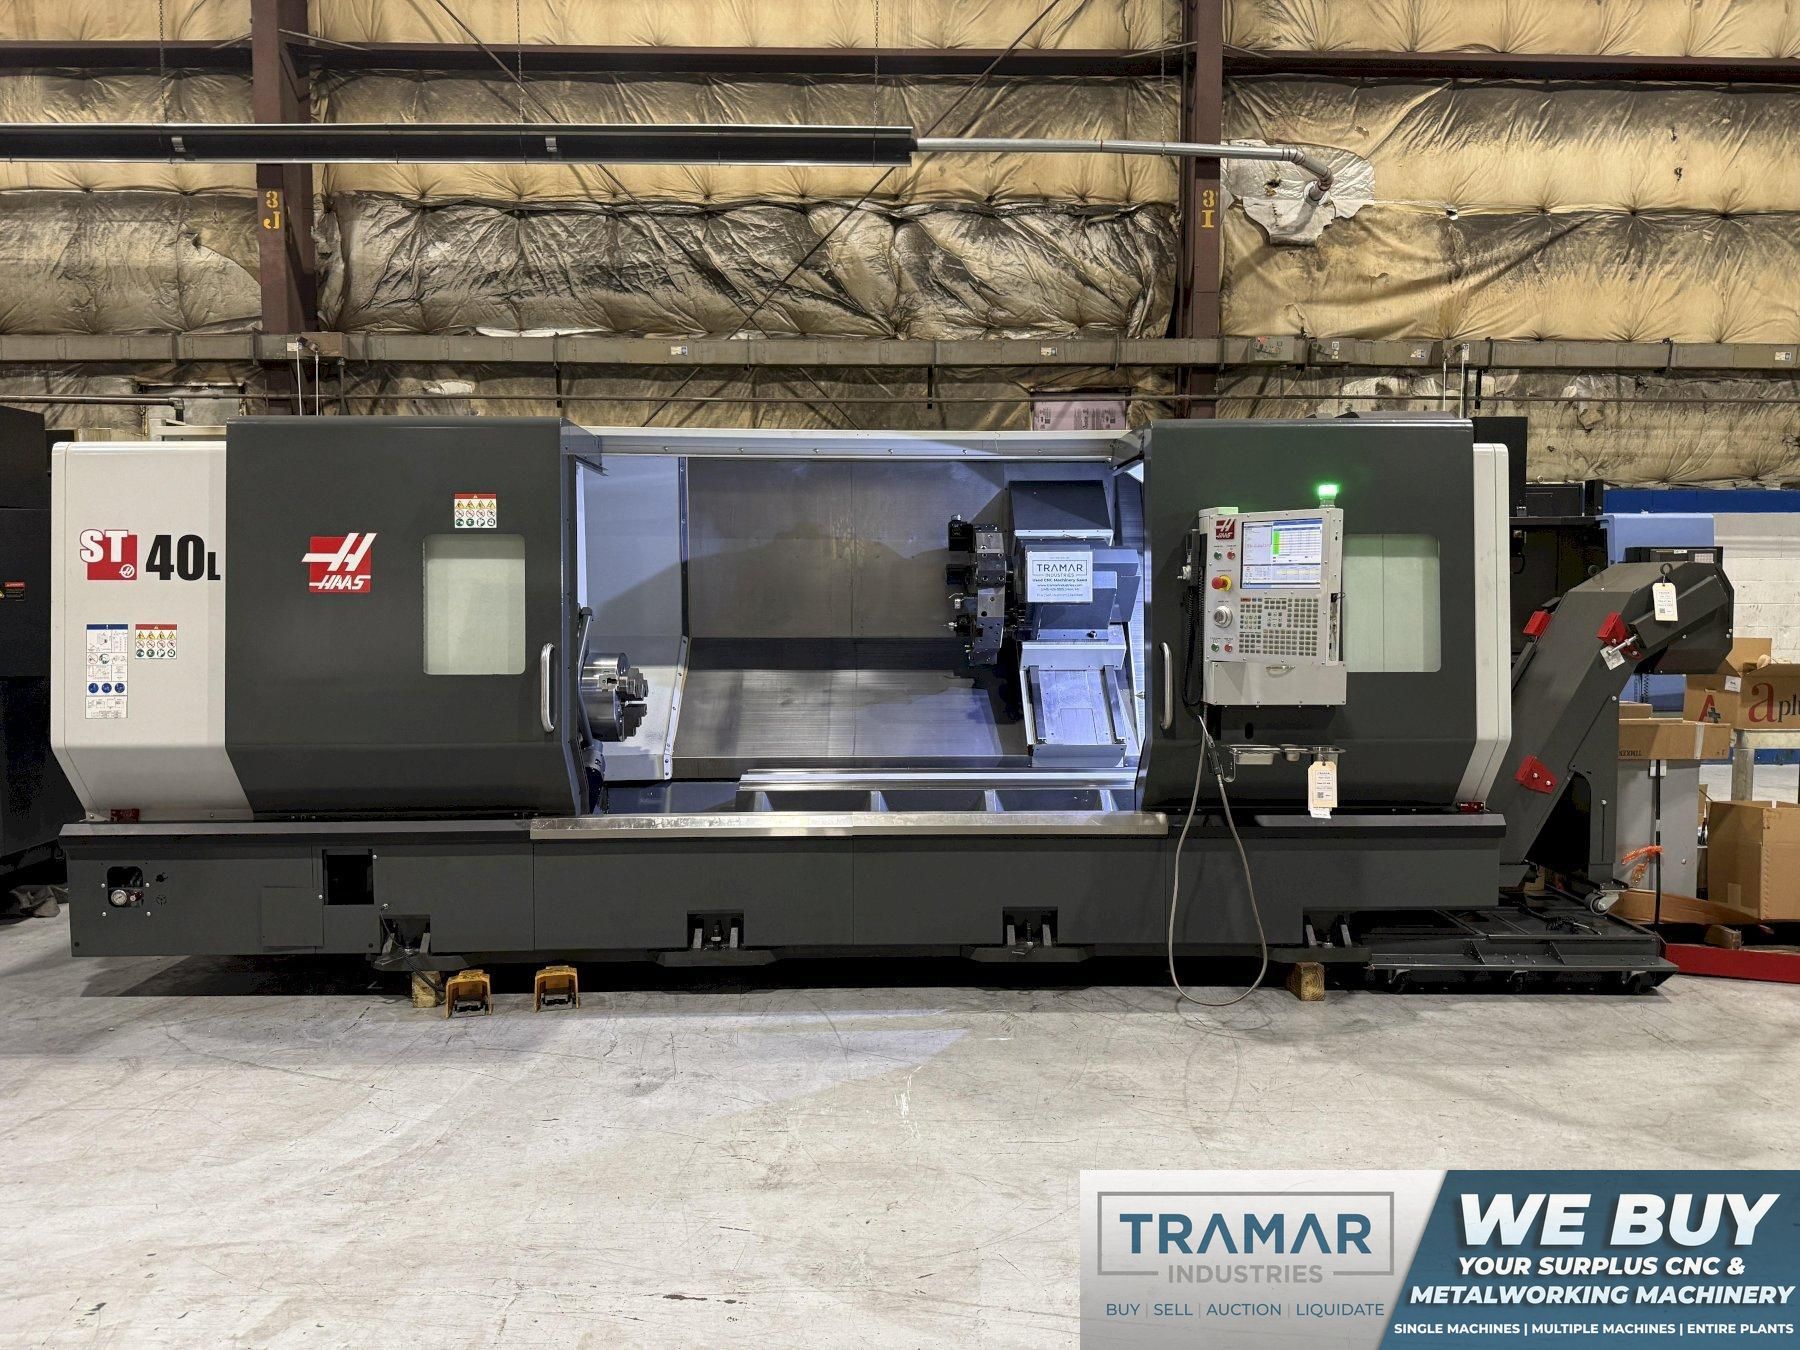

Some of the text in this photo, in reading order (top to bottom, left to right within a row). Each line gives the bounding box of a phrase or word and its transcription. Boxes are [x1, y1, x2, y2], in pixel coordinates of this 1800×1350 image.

[79, 528, 221, 581] ST 40L
[1036, 563, 1084, 572] TRAMAR
[308, 574, 372, 590] HAAS
